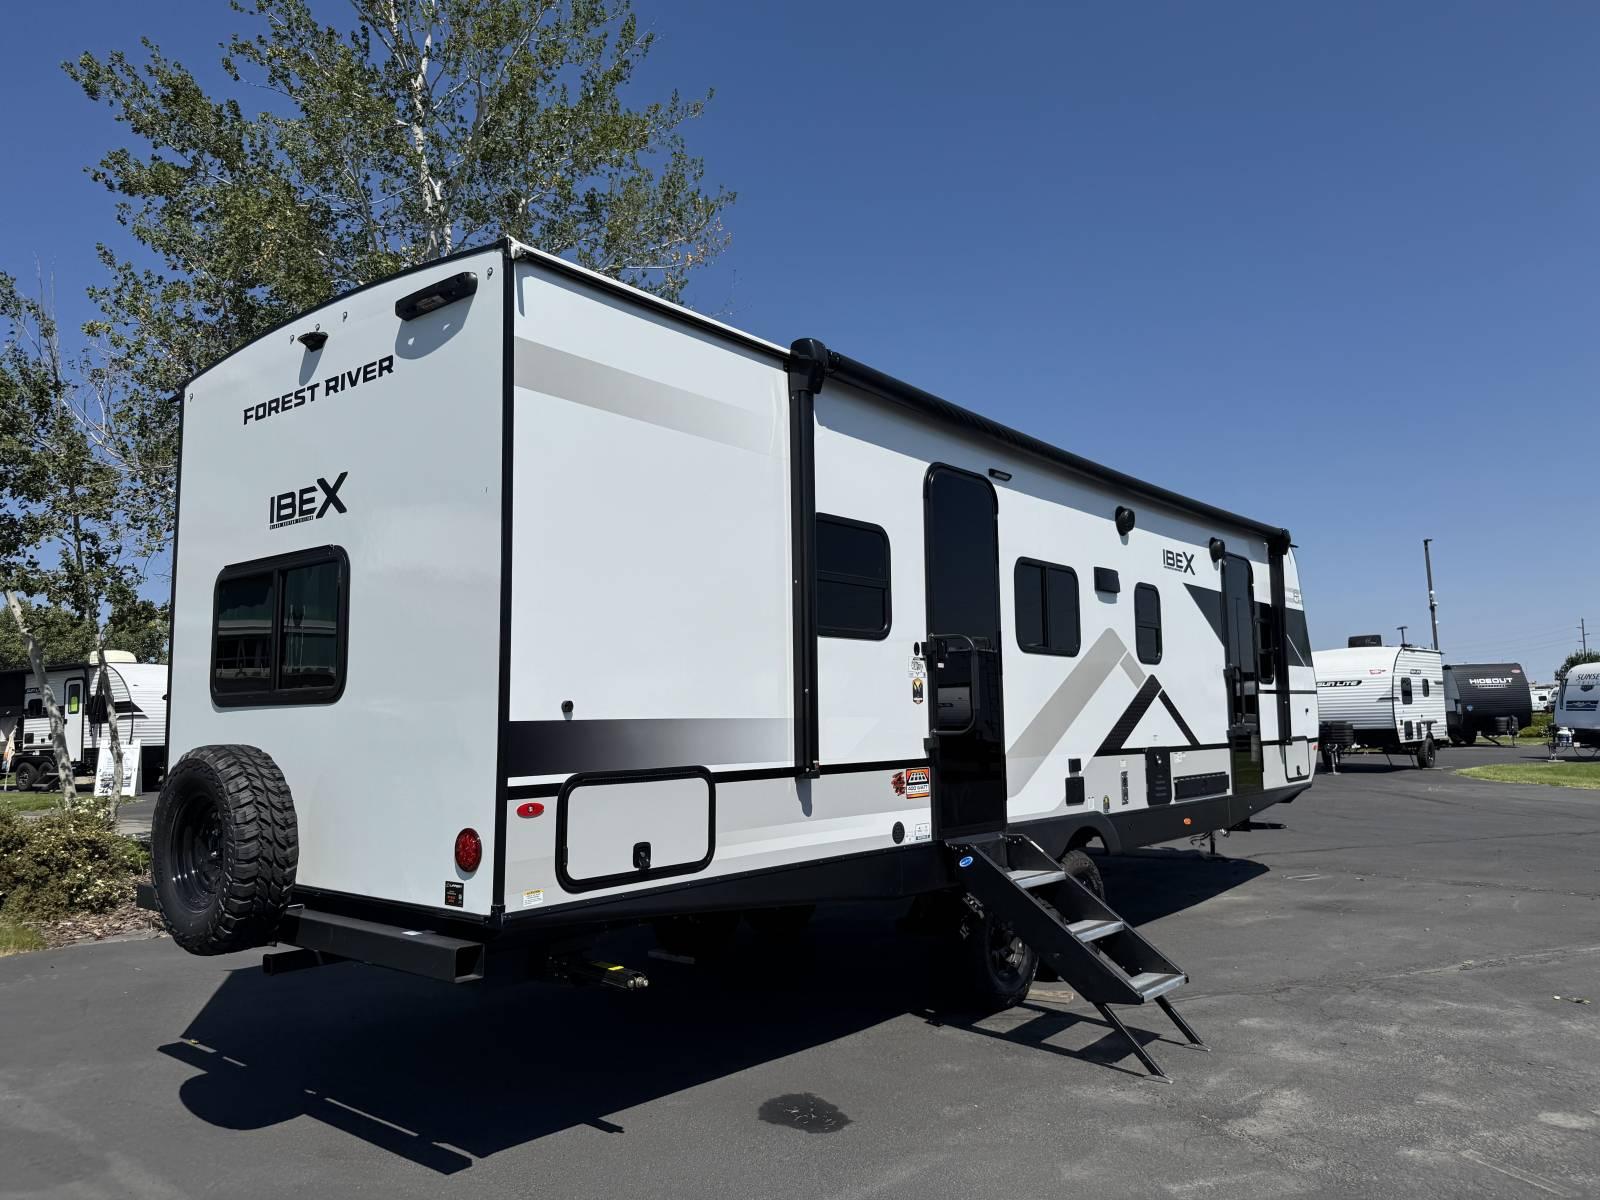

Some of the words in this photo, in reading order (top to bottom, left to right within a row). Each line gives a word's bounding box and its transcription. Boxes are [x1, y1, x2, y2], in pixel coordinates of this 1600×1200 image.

[243, 382, 320, 426] FOREST
[324, 354, 394, 397] RIVER
[269, 471, 349, 524] IBEX
[1162, 548, 1196, 576] IBEX
[1468, 677, 1513, 685] HIDEOUT
